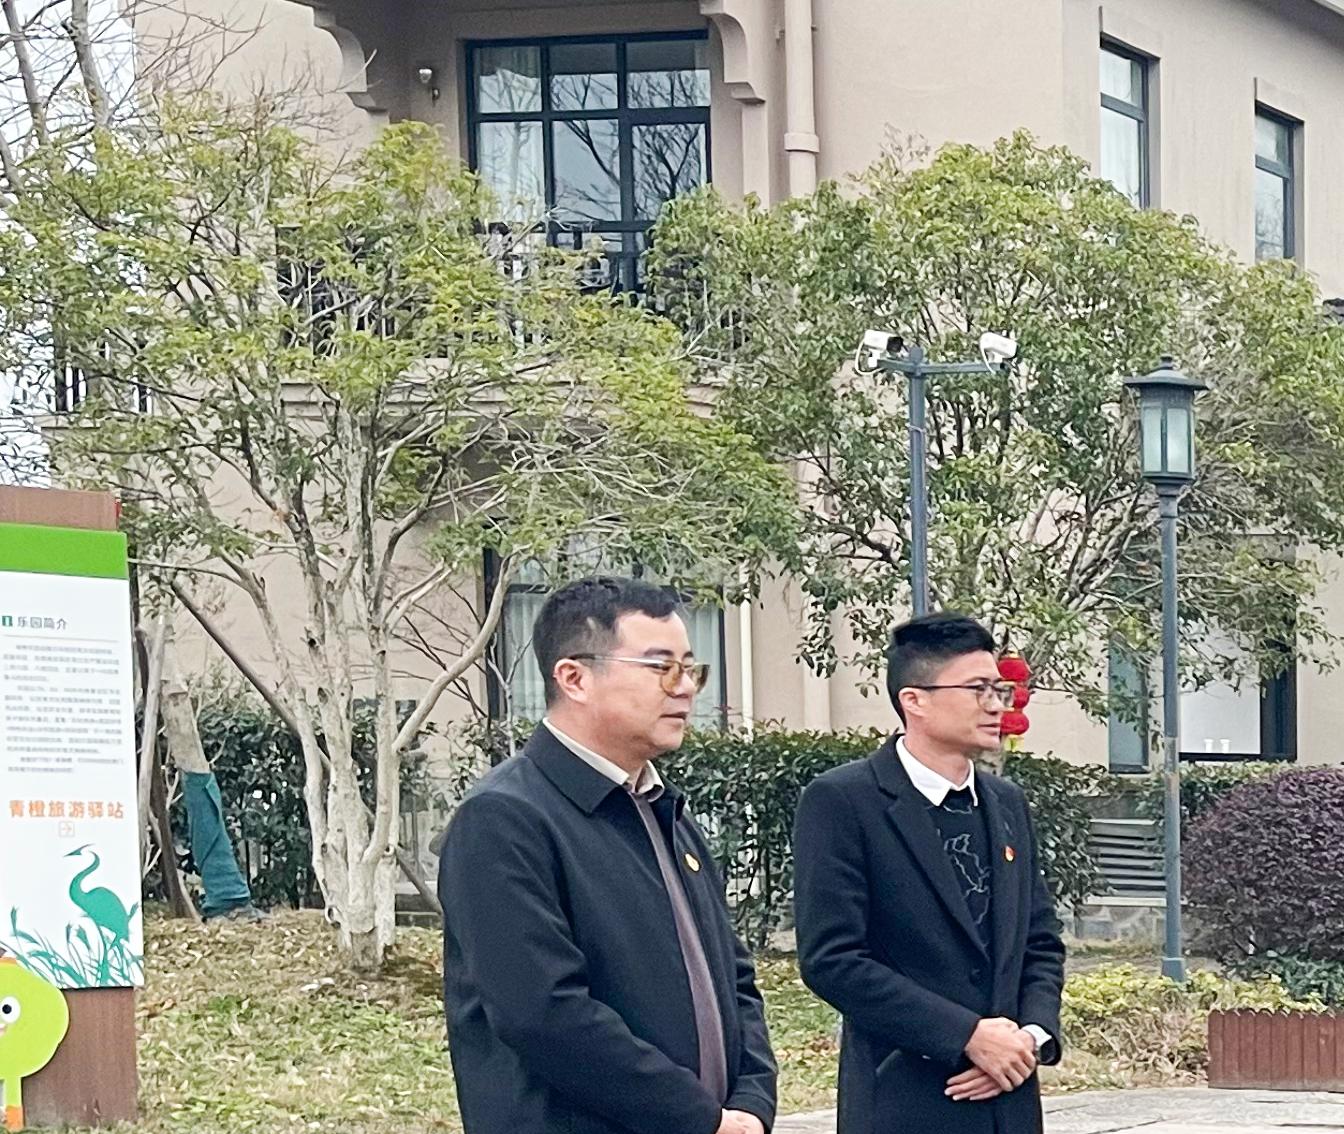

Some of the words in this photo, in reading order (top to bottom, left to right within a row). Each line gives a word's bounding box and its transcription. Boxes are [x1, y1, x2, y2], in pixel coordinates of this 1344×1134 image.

[17, 616, 67, 630] 乐园简介
[9, 800, 124, 819] 青橙旅游驿站
